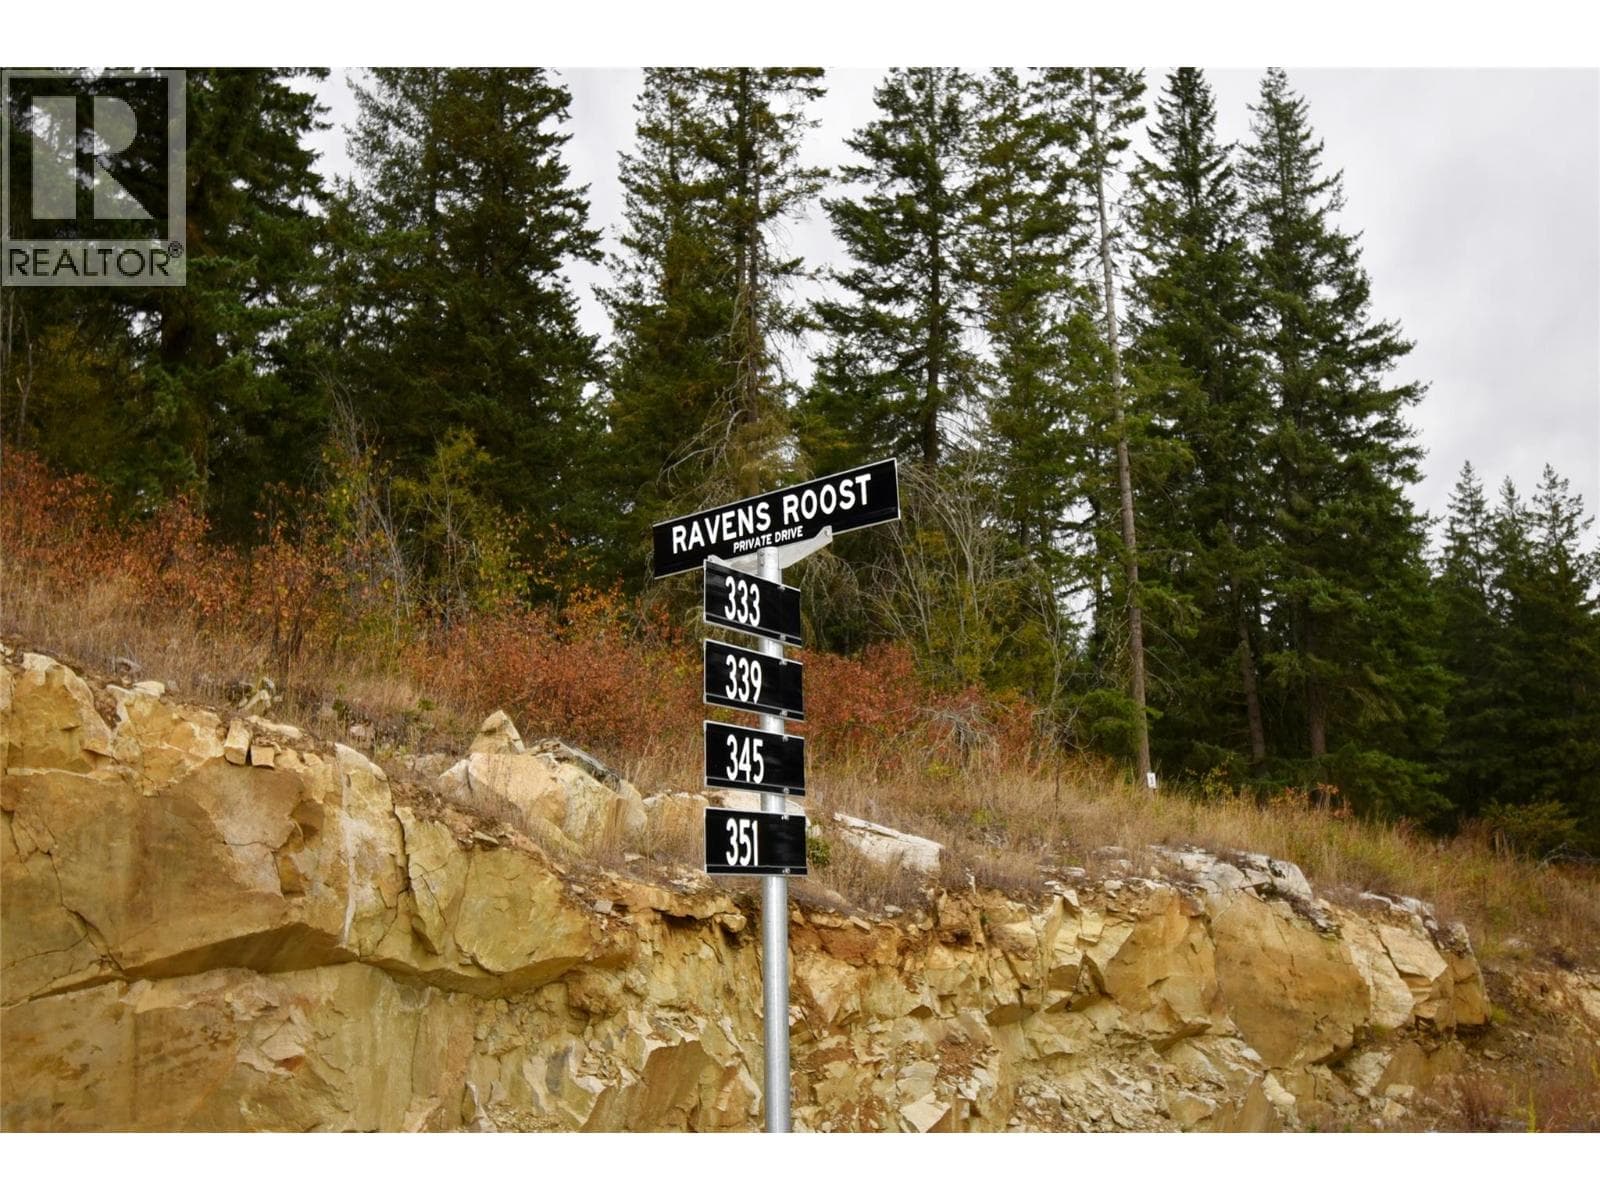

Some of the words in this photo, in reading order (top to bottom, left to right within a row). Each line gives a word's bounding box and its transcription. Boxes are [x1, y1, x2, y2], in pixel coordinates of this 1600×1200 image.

[671, 502, 771, 554] RAVENS
[782, 473, 871, 526] ROOST
[733, 533, 772, 553] PRIVATE
[774, 526, 804, 543] DRIVE
[724, 575, 761, 628] 333
[725, 654, 762, 704] 339
[726, 734, 764, 785] 345
[726, 818, 759, 867] 351
